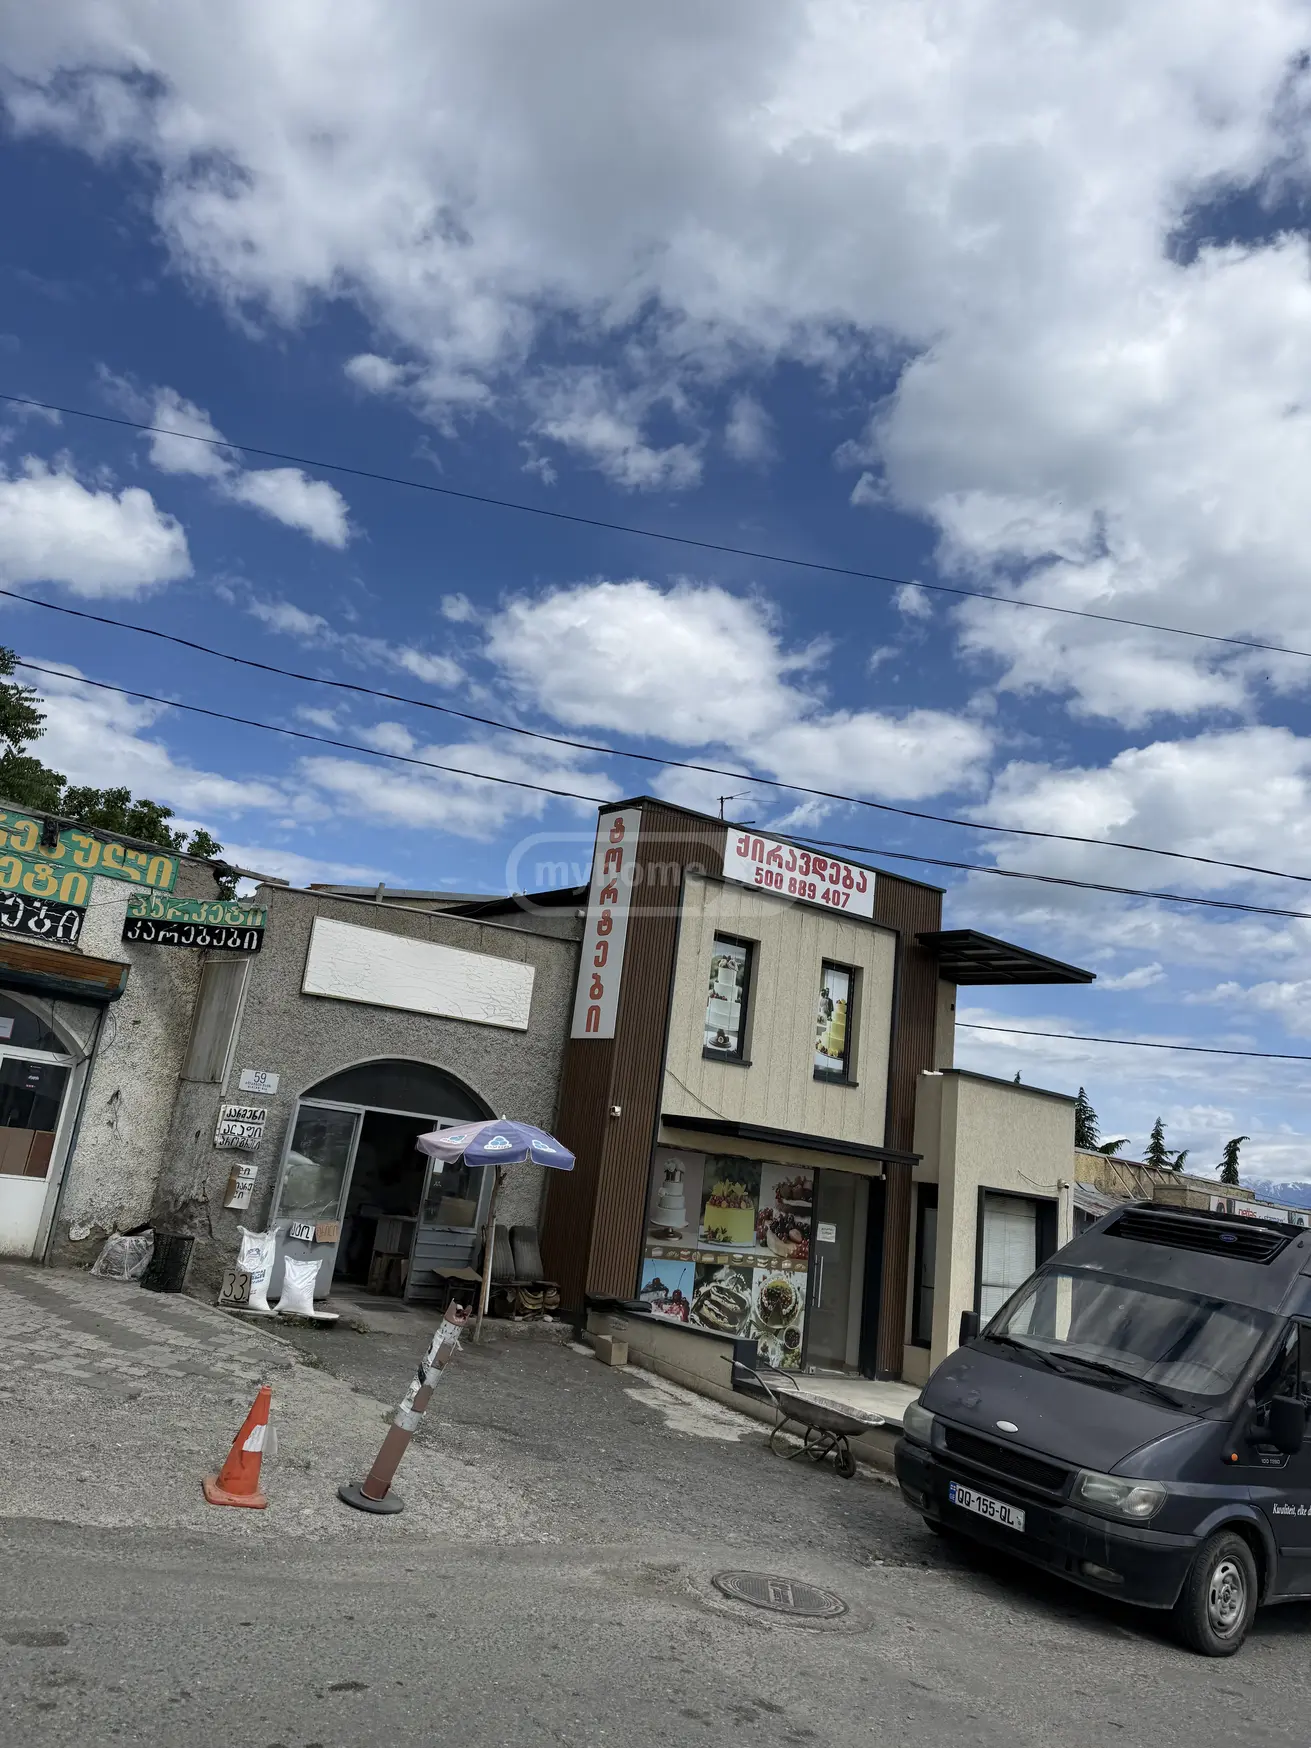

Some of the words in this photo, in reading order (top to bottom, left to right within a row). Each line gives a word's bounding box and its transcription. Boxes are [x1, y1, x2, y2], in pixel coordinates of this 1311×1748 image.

[736, 834, 867, 893] ქირავდება
[754, 866, 784, 890] 500
[788, 876, 817, 900] 889
[821, 887, 851, 908] 407
[127, 920, 258, 950] კარებები
[585, 817, 624, 1033] ტორტები
[253, 1071, 267, 1084] 59
[957, 1488, 1014, 1525] QQ-155-QL
